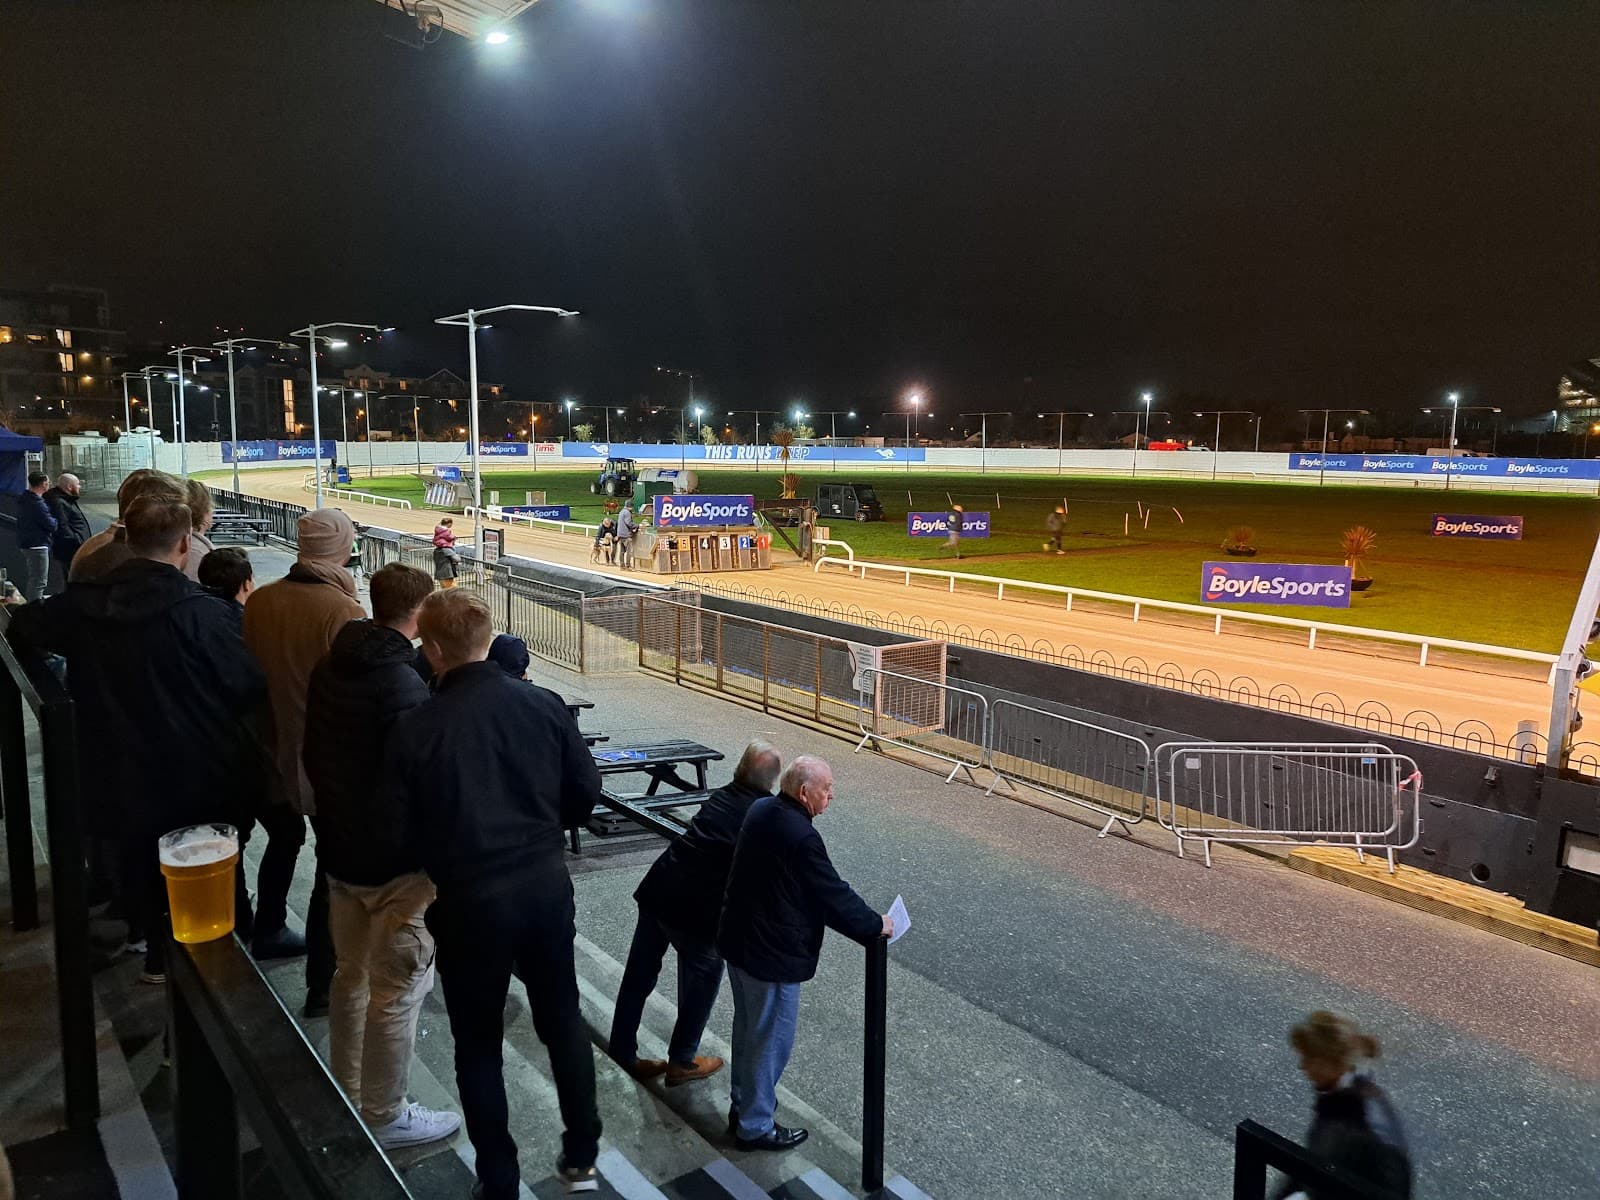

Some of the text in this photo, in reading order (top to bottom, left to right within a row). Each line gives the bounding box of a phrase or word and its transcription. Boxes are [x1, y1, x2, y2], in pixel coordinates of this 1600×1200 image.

[278, 445, 325, 457] BoyleSpors
[705, 445, 733, 459] THIS
[736, 445, 772, 459] RUNS
[1363, 459, 1415, 470] BoyleSports
[1431, 461, 1488, 472] BoyleSports
[1507, 463, 1569, 475] BoyleSports
[661, 502, 749, 521] BoyleSports
[911, 519, 987, 533] Boyleorts
[1435, 520, 1518, 536] BoyleSports
[702, 537, 709, 549] 4
[722, 538, 728, 548] 3
[742, 538, 747, 548] 2
[1208, 574, 1346, 600] BoyleSports
